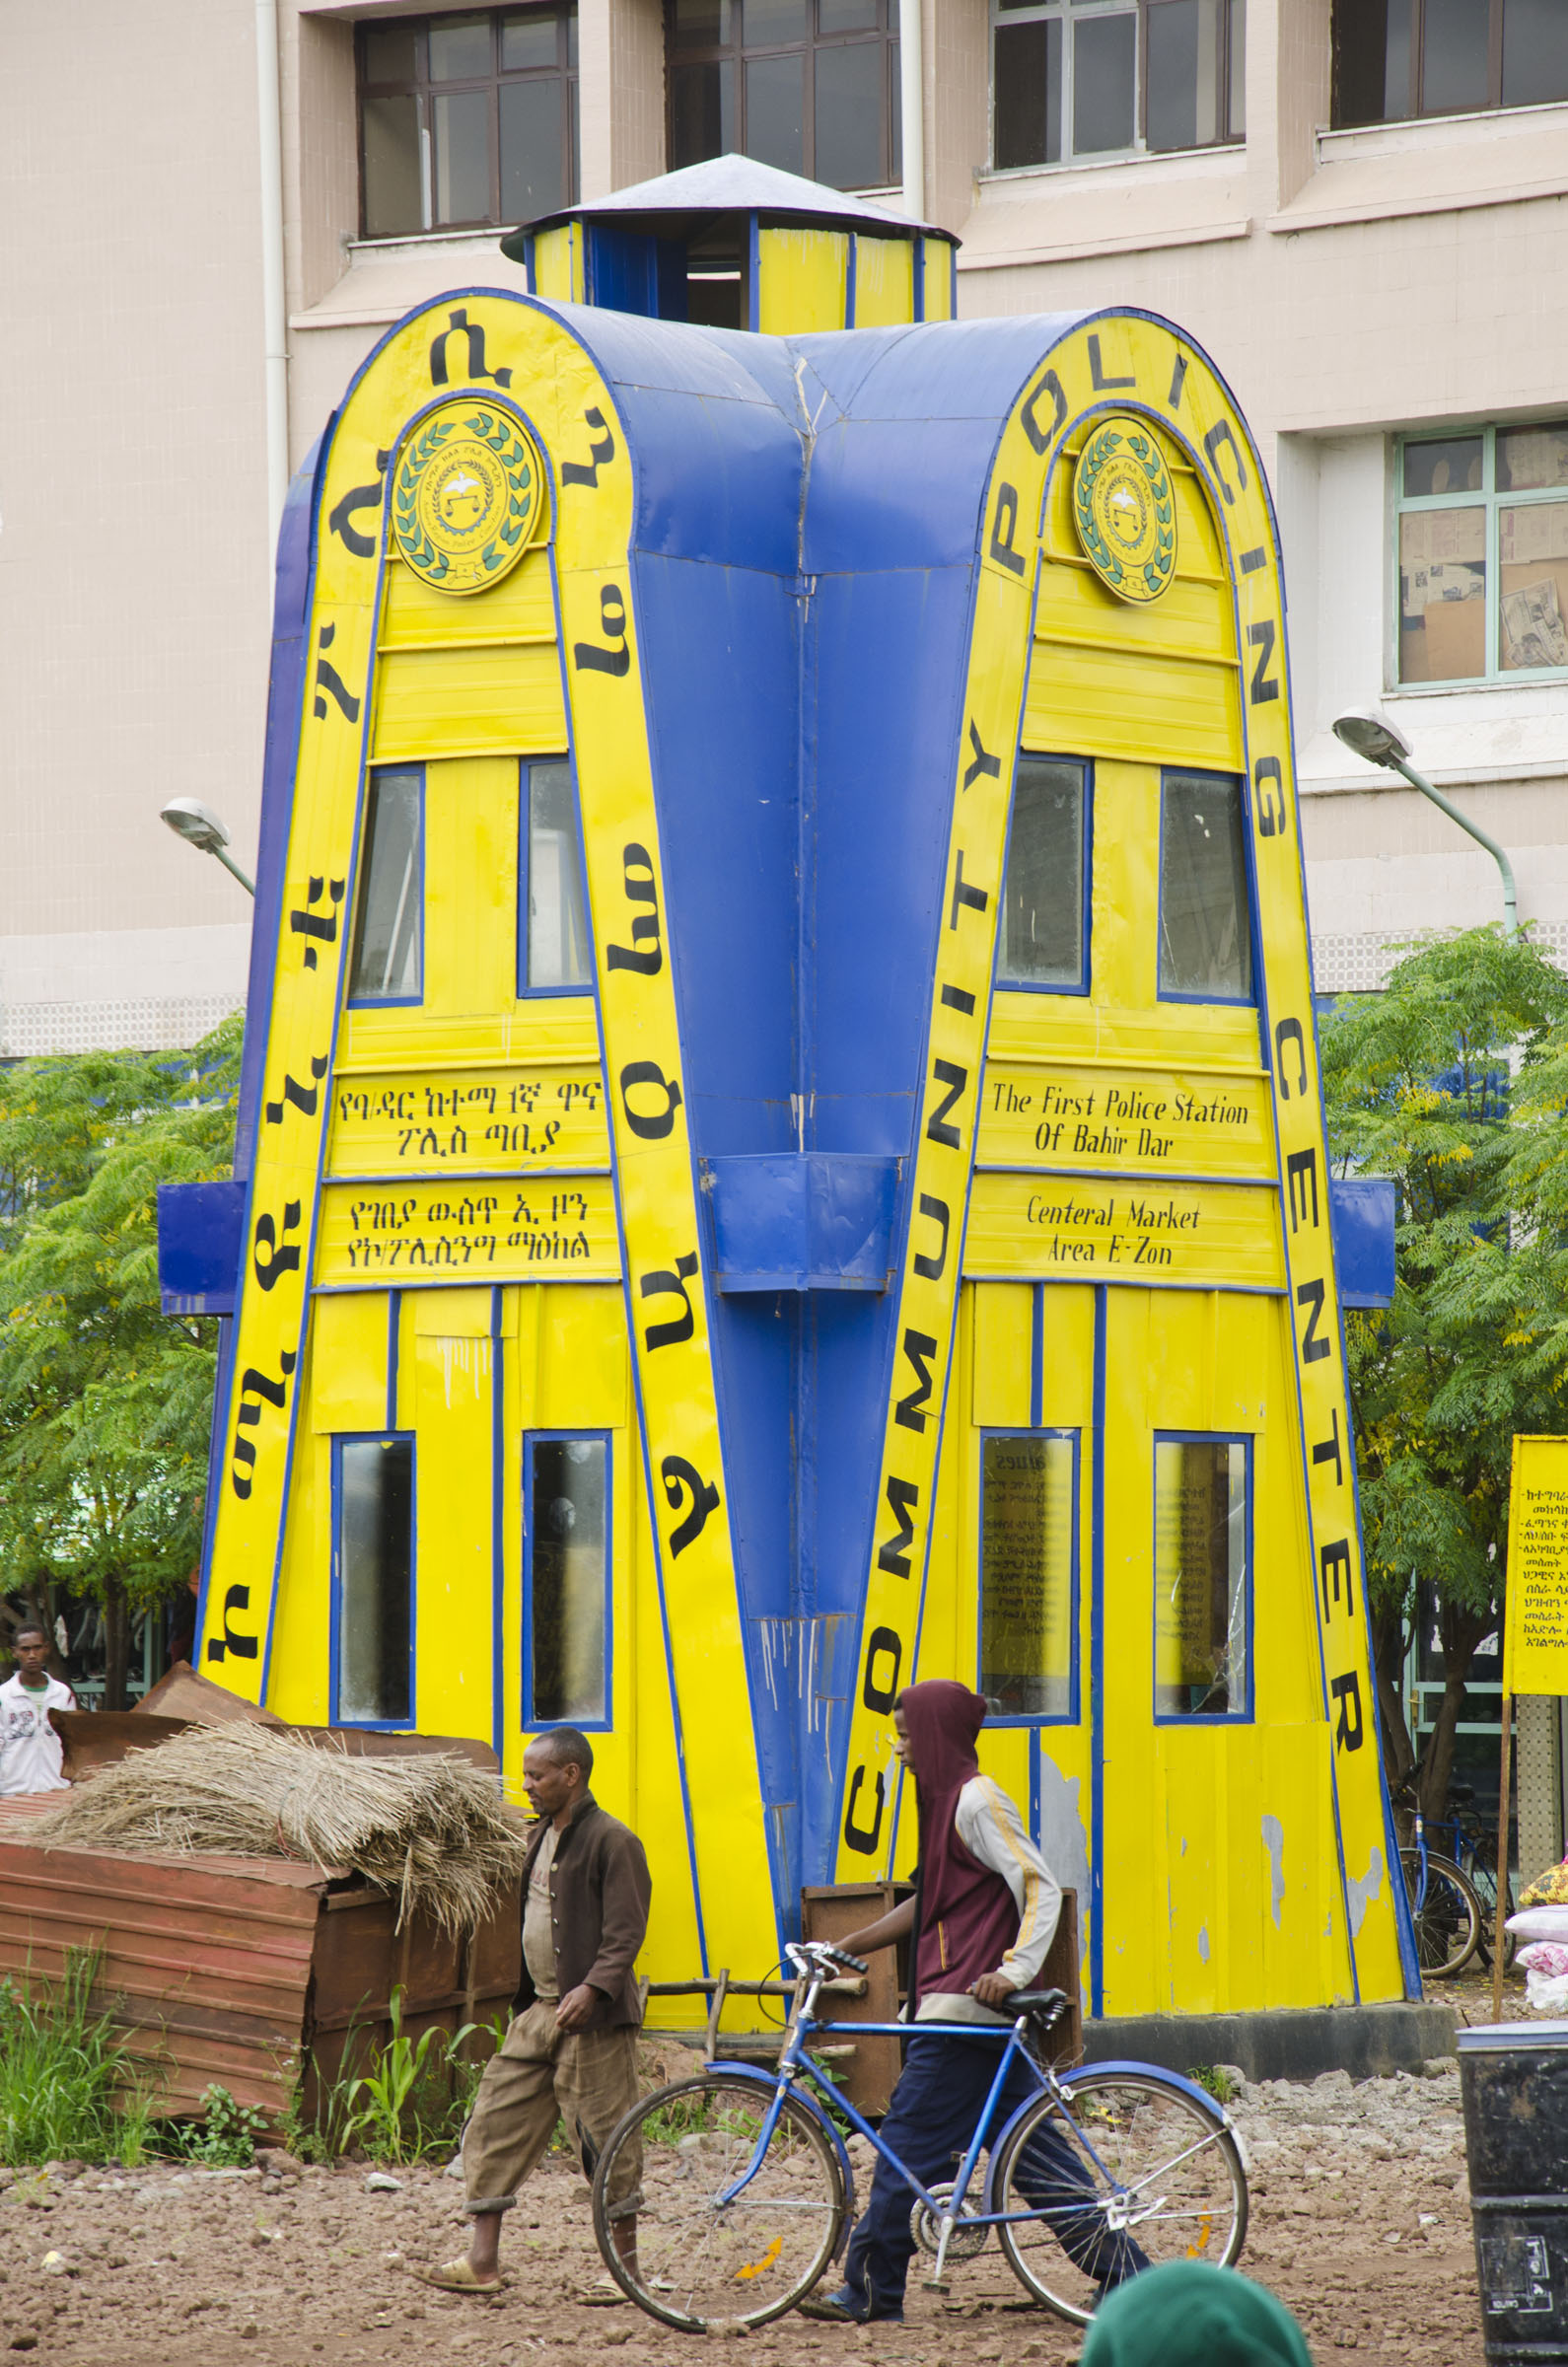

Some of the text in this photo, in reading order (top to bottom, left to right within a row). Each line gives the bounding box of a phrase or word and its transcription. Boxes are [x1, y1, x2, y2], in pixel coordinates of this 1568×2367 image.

[425, 1086, 497, 1117] ከተማ
[507, 1082, 541, 1114] 1ኛ
[557, 1082, 602, 1112] ዋና
[844, 334, 1363, 1856] COMMUNITY POLICING CENTER
[993, 1083, 1248, 1124] The First Police Station
[398, 1120, 561, 1157] ፖሊስ ጣቢያ
[1034, 1122, 1174, 1157] Of Bahir Dar
[427, 1196, 498, 1226] ውስጥ
[607, 843, 720, 1560] ማዕከል
[1027, 1195, 1201, 1229] Centeral Market
[507, 1230, 591, 1261] ማዕከል
[1048, 1233, 1173, 1264] Area E-Zon
